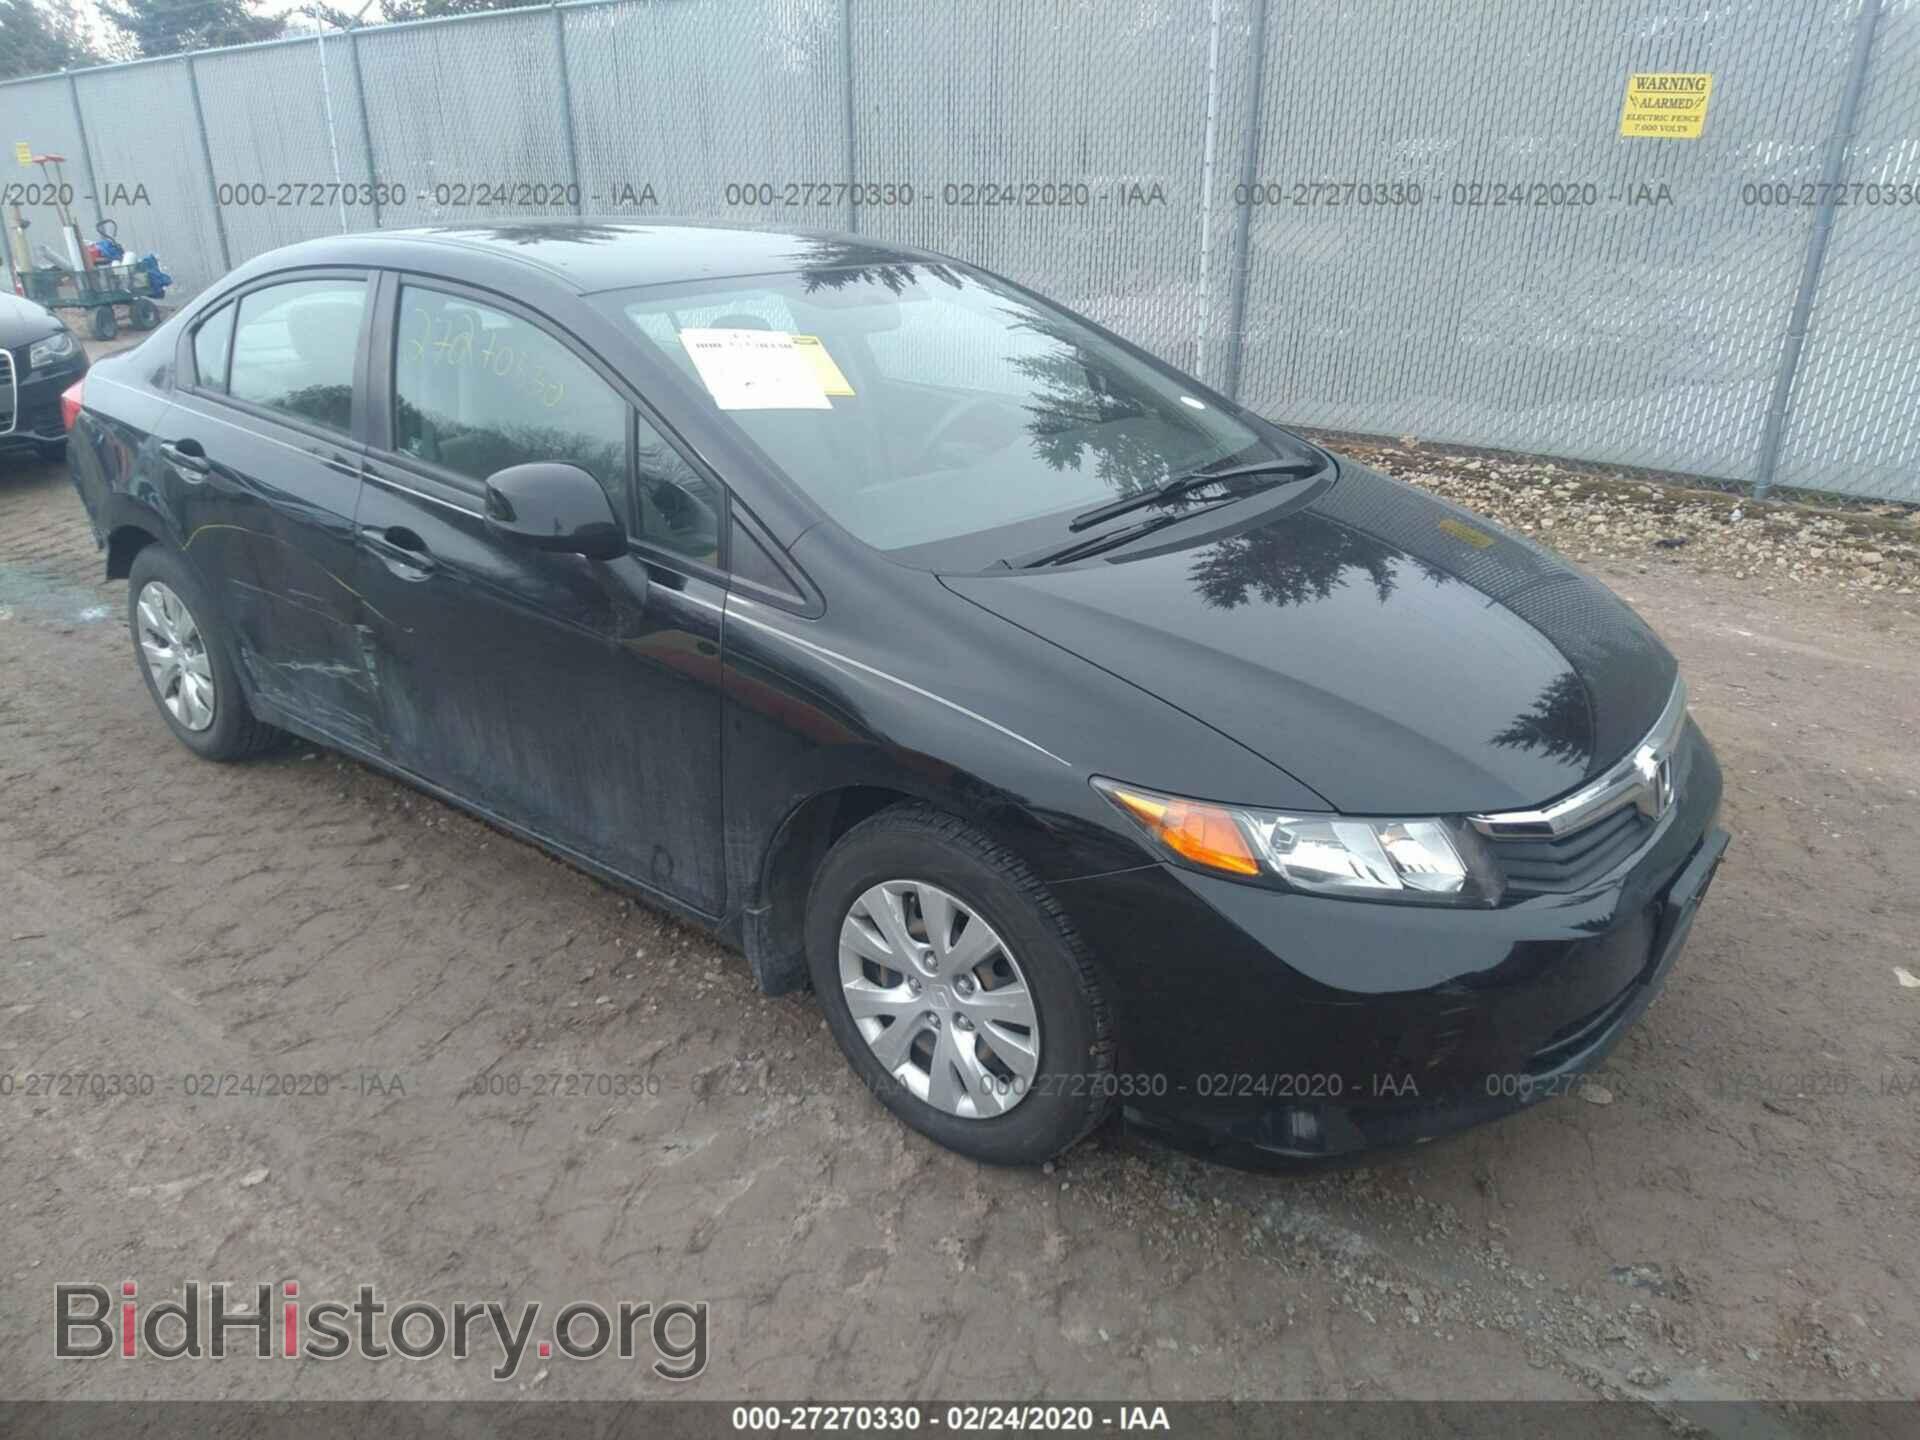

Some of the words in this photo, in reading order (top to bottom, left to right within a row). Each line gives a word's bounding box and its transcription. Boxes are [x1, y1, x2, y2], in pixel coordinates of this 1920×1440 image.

[1636, 77, 1707, 91] WARNING
[1639, 97, 1694, 109] ALARMED
[1626, 113, 1669, 121] ELECTRIC
[1660, 124, 1688, 132] VOLTS
